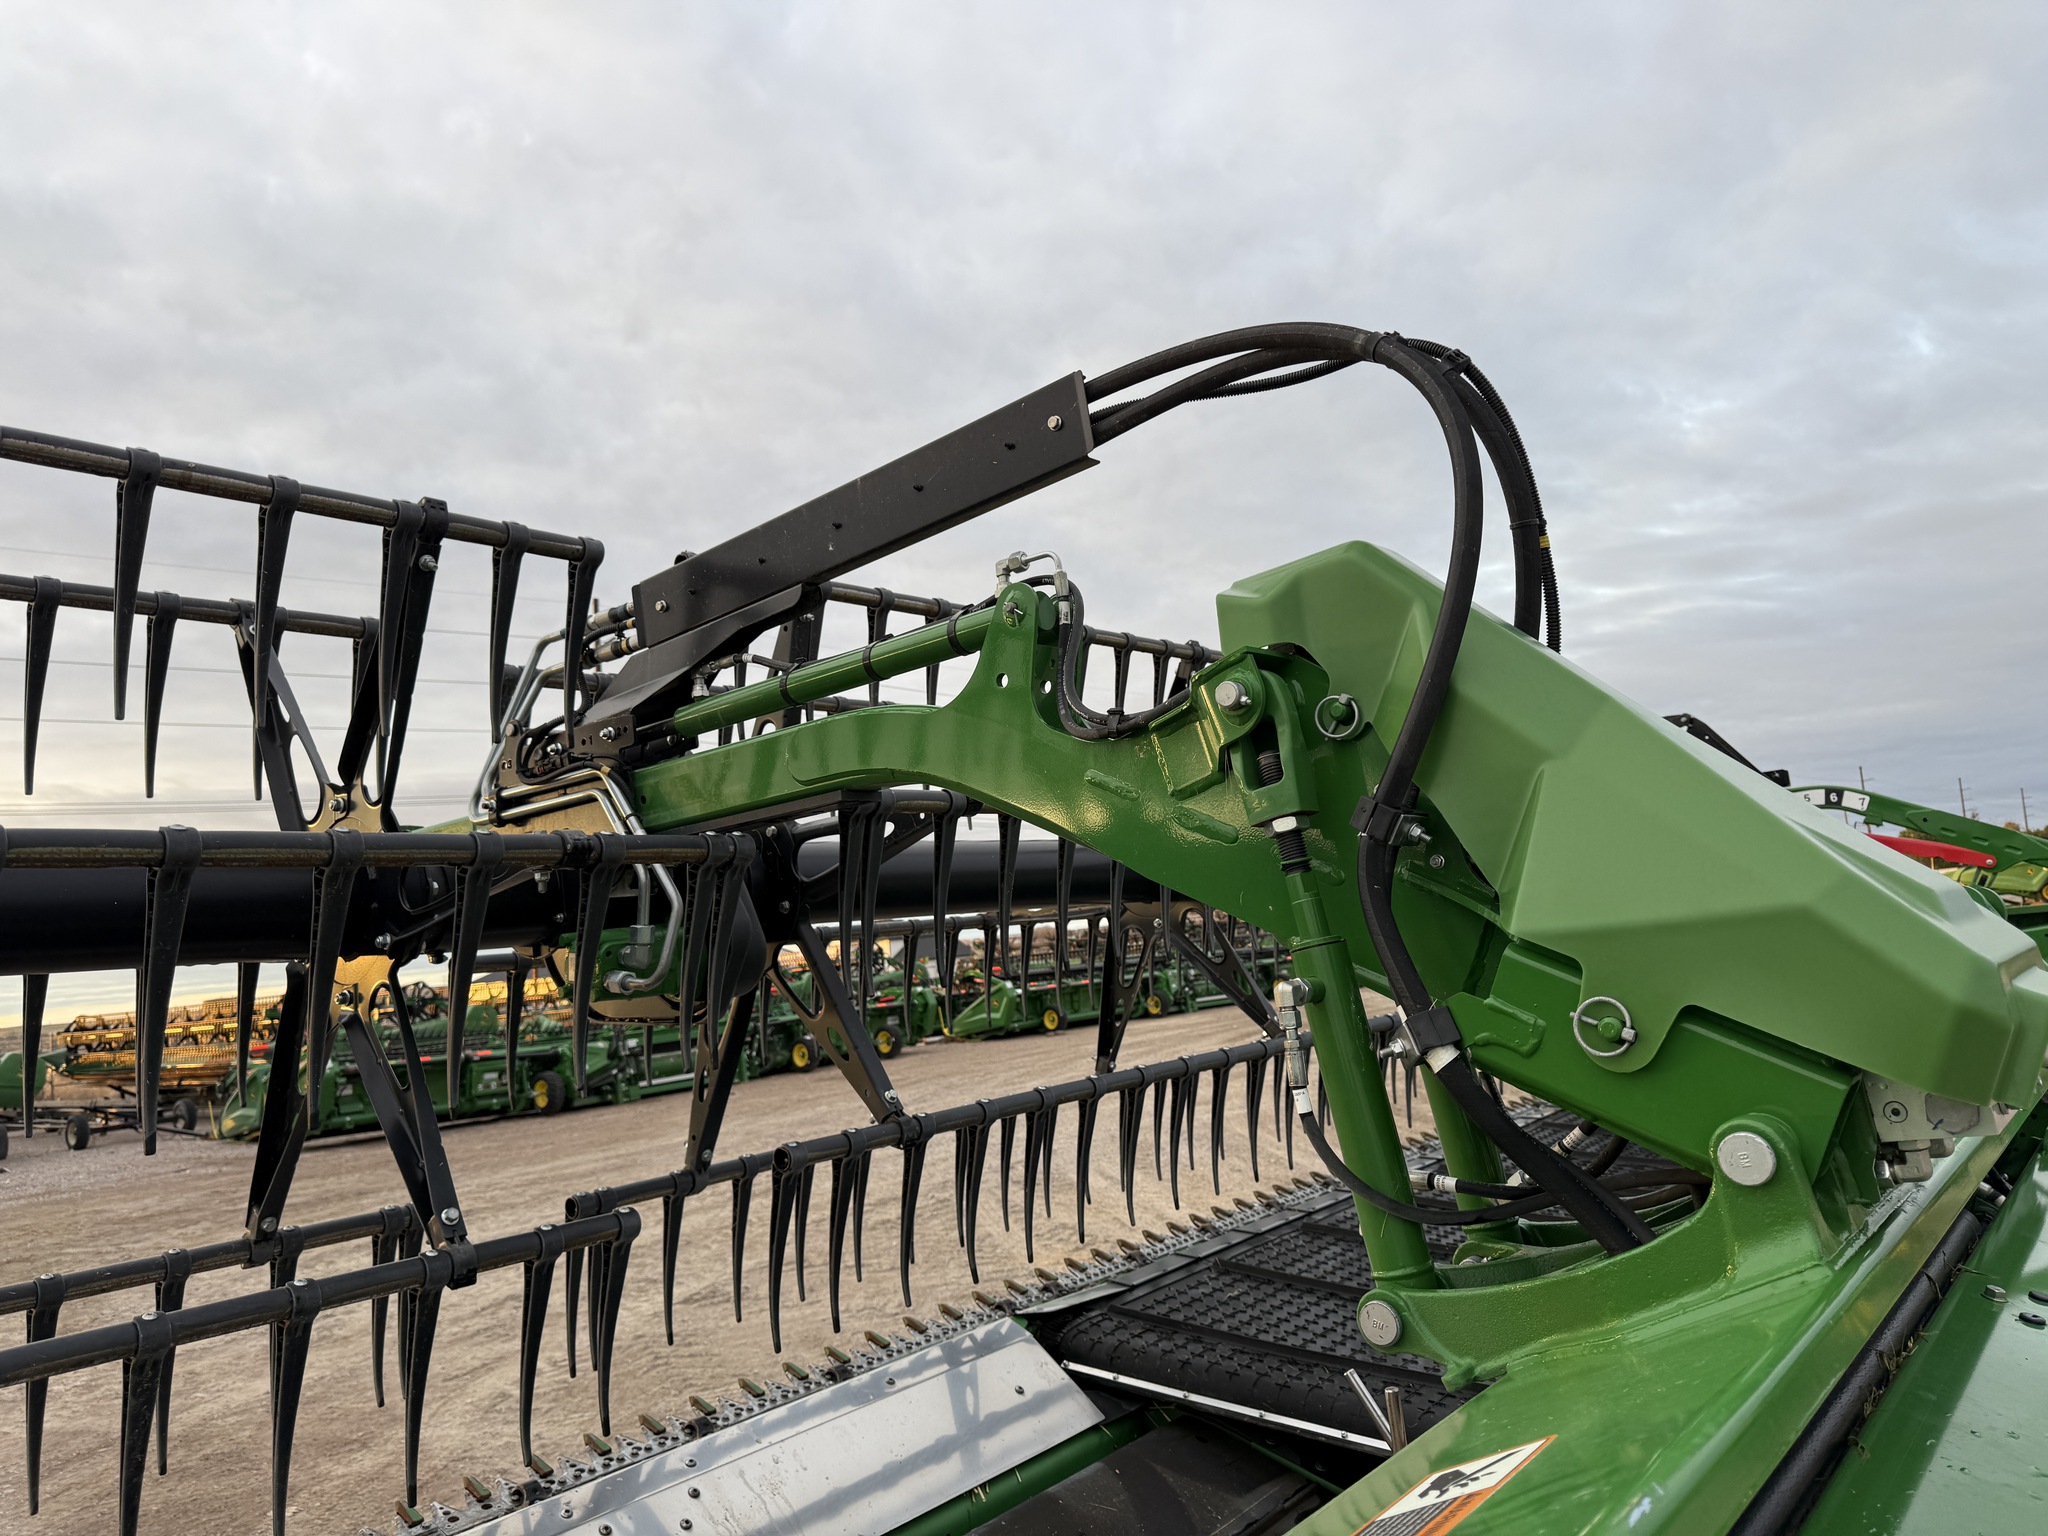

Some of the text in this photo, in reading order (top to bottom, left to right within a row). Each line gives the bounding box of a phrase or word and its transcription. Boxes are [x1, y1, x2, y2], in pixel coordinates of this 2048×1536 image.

[1804, 792, 1866, 806] 5 6 7
